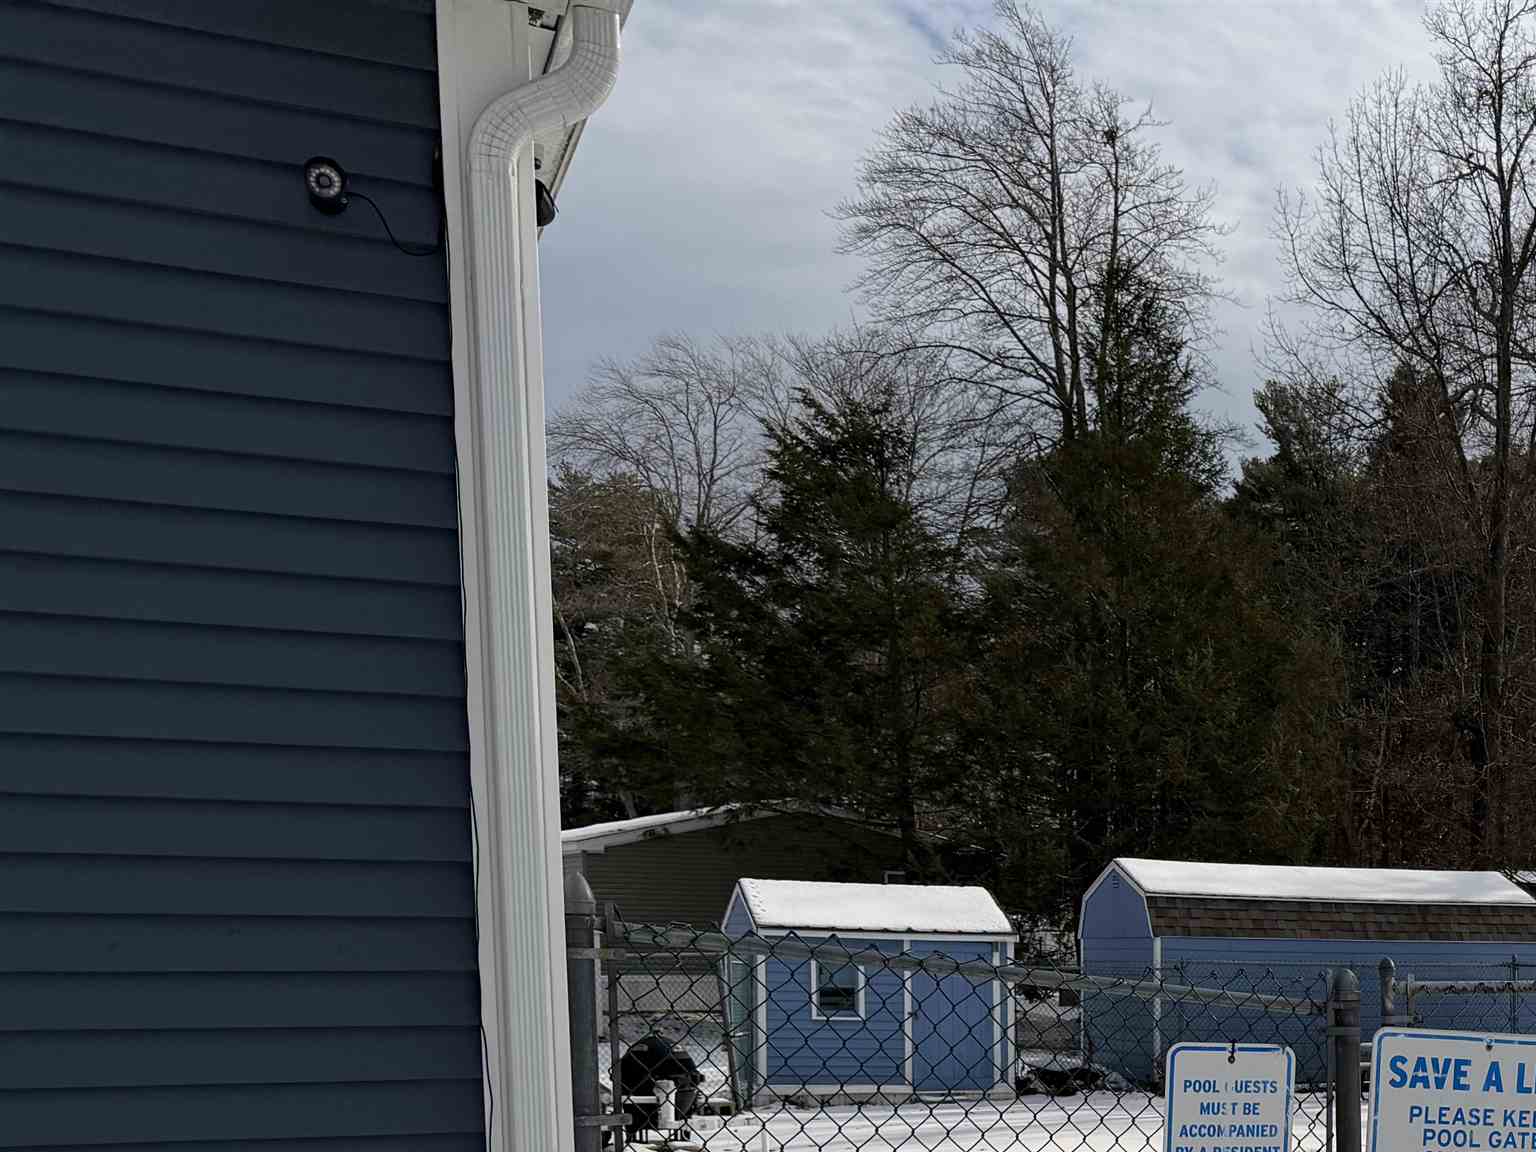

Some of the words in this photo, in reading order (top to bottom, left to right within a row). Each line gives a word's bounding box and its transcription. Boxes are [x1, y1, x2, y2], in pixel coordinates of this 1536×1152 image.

[1389, 1055, 1472, 1092] SAVE
[1482, 1061, 1504, 1093] A
[1184, 1080, 1219, 1093] POOL
[1243, 1103, 1261, 1115] BE
[1409, 1106, 1495, 1126] PLEASE
[1423, 1129, 1481, 1148] POOL
